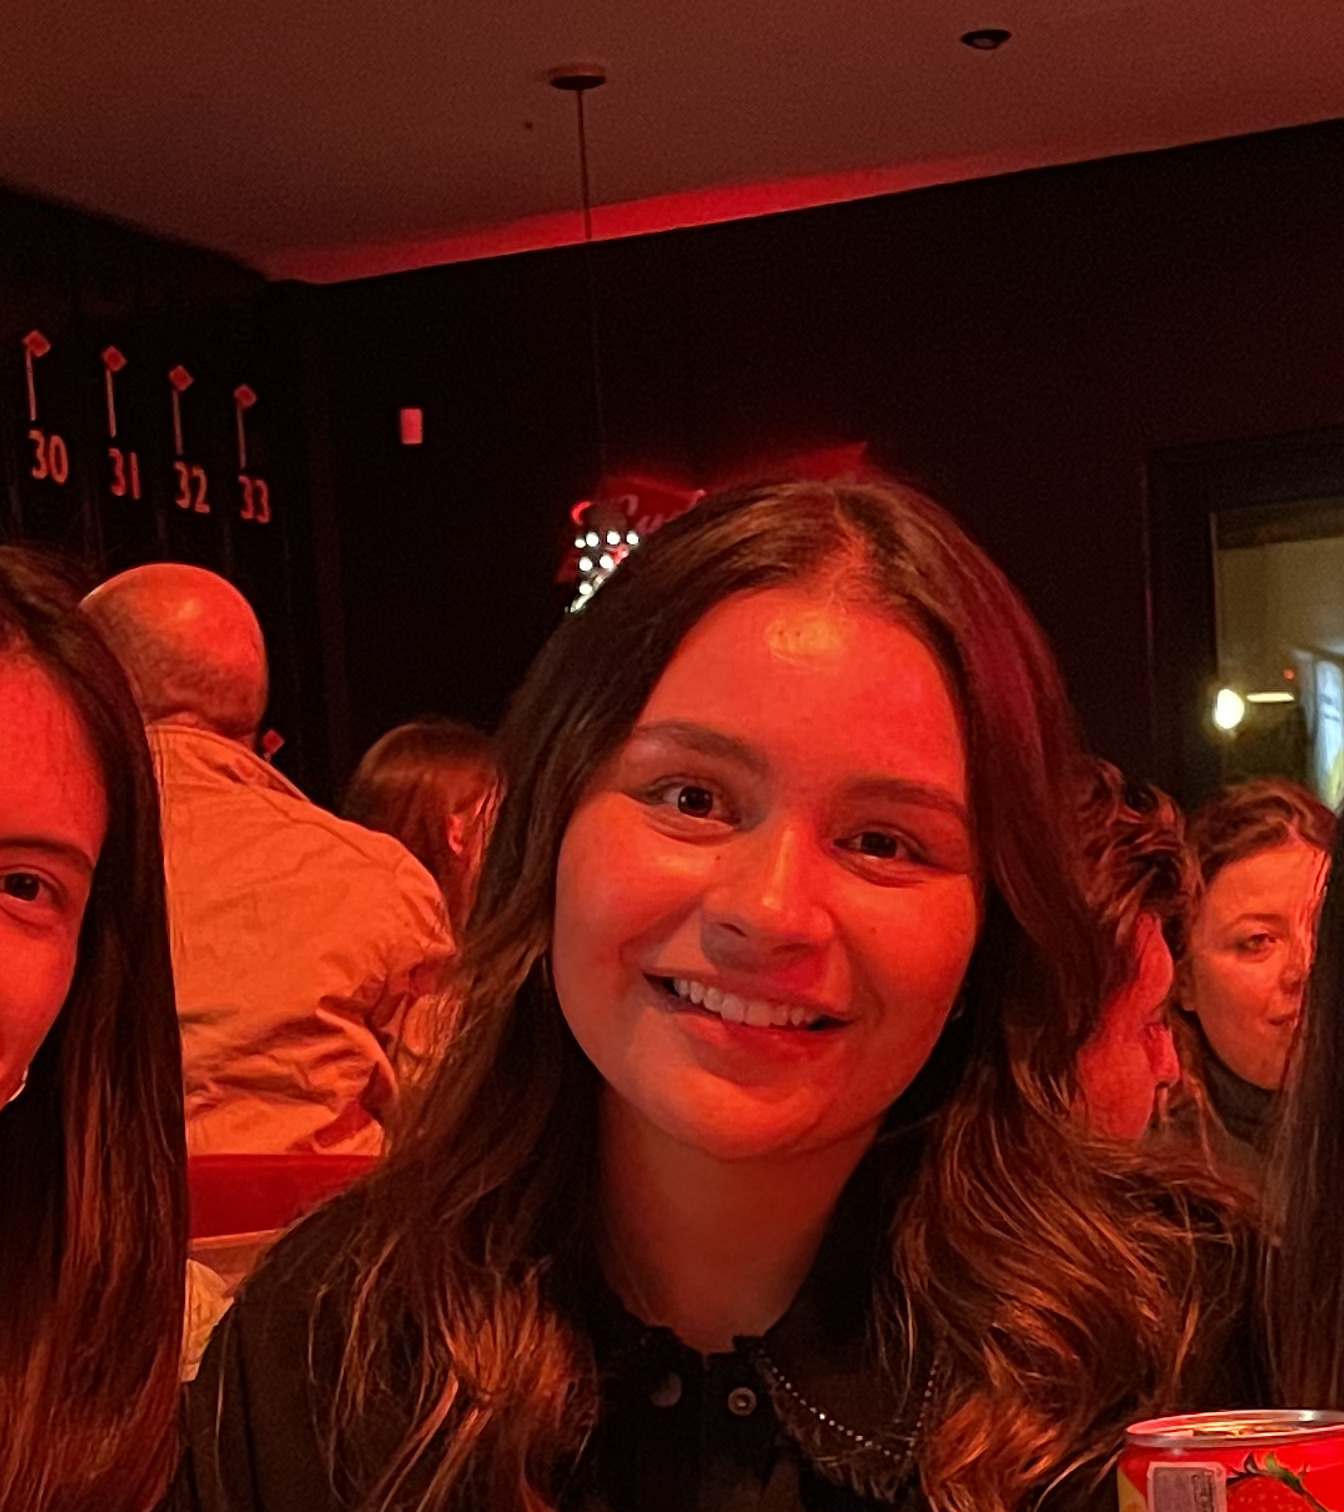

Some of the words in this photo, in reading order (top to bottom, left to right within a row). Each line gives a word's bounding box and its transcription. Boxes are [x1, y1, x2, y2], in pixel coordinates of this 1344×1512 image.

[29, 429, 69, 485] 30
[109, 447, 141, 500] 31
[173, 461, 211, 514] 32
[238, 474, 271, 524] 33
